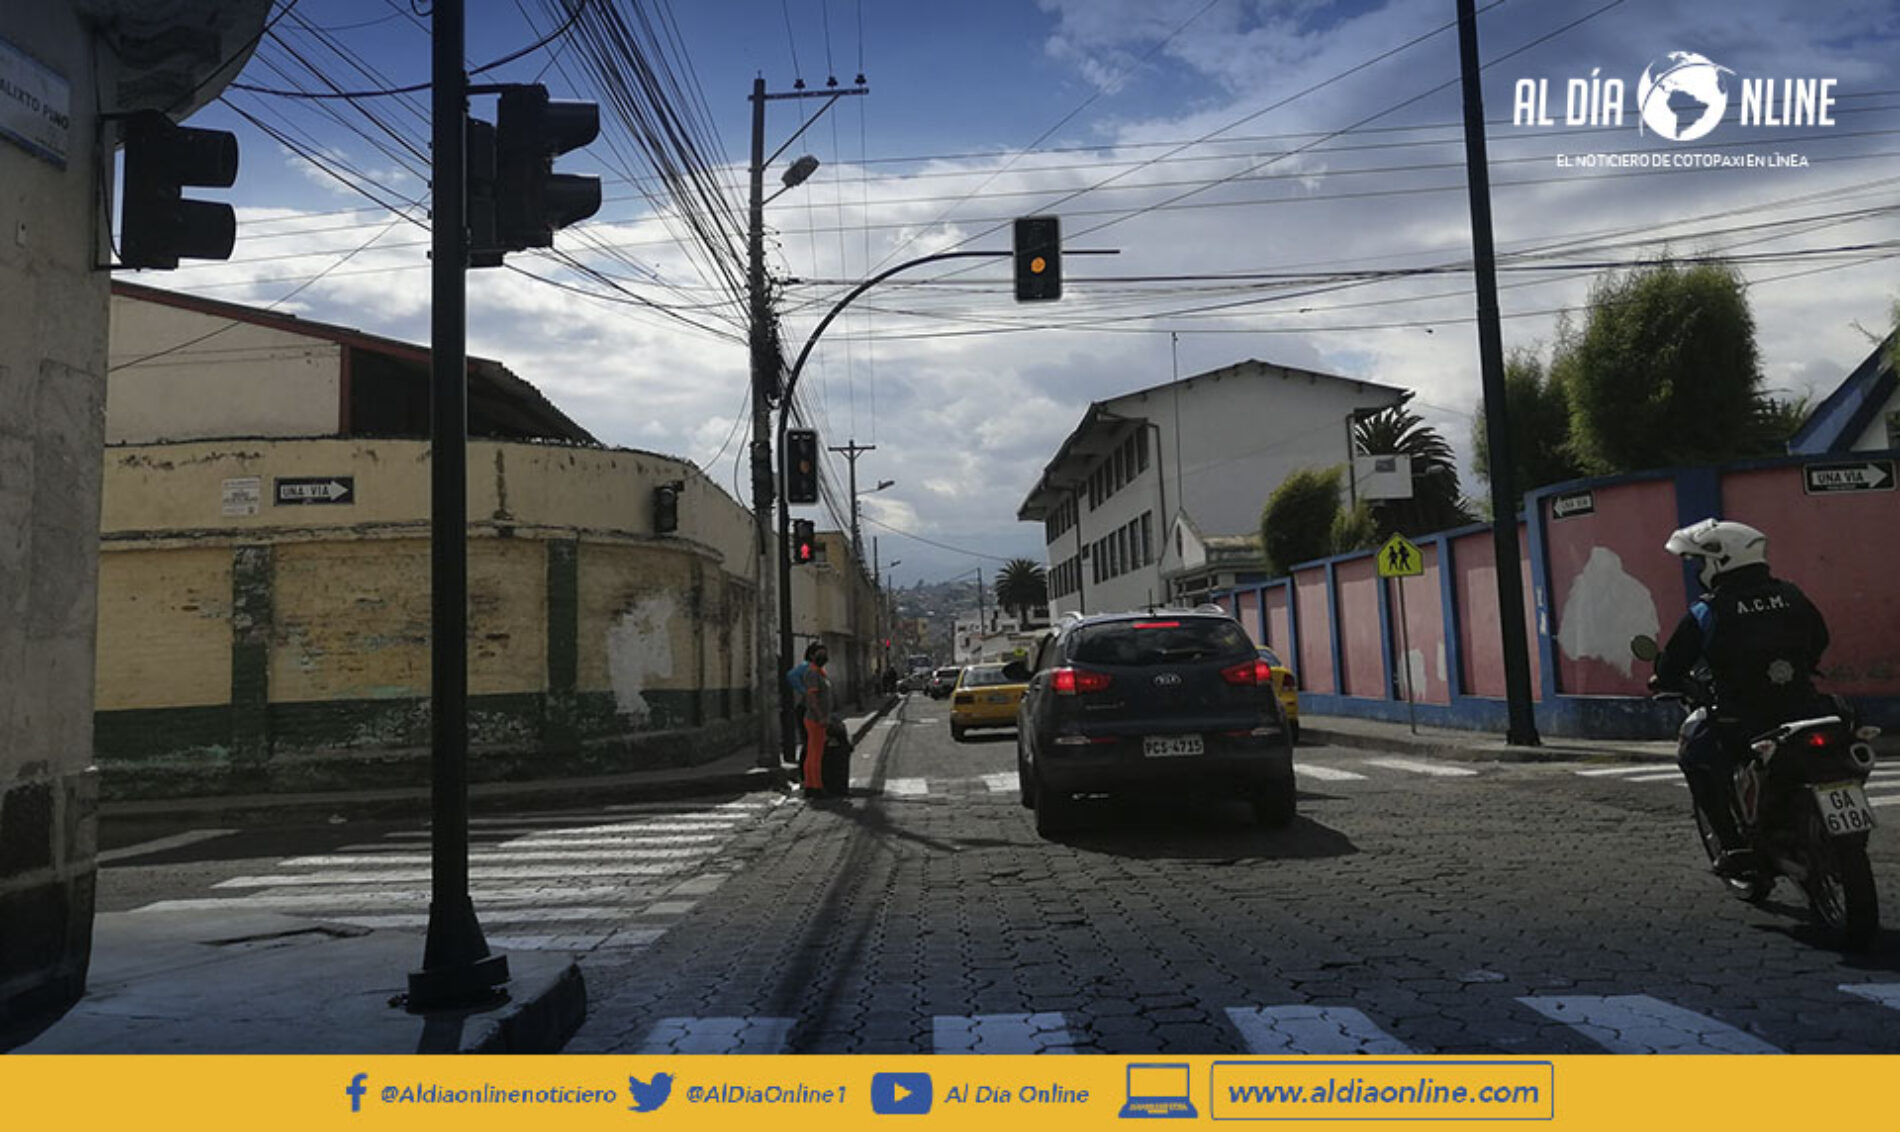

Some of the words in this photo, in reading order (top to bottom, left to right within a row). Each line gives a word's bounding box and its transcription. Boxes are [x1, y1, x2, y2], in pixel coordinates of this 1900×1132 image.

[1817, 470, 1842, 484] UNA
[282, 486, 305, 498] UNA
[1736, 594, 1791, 614] A.C.M.
[1829, 789, 1856, 810] GA
[1827, 808, 1879, 831] 618A
